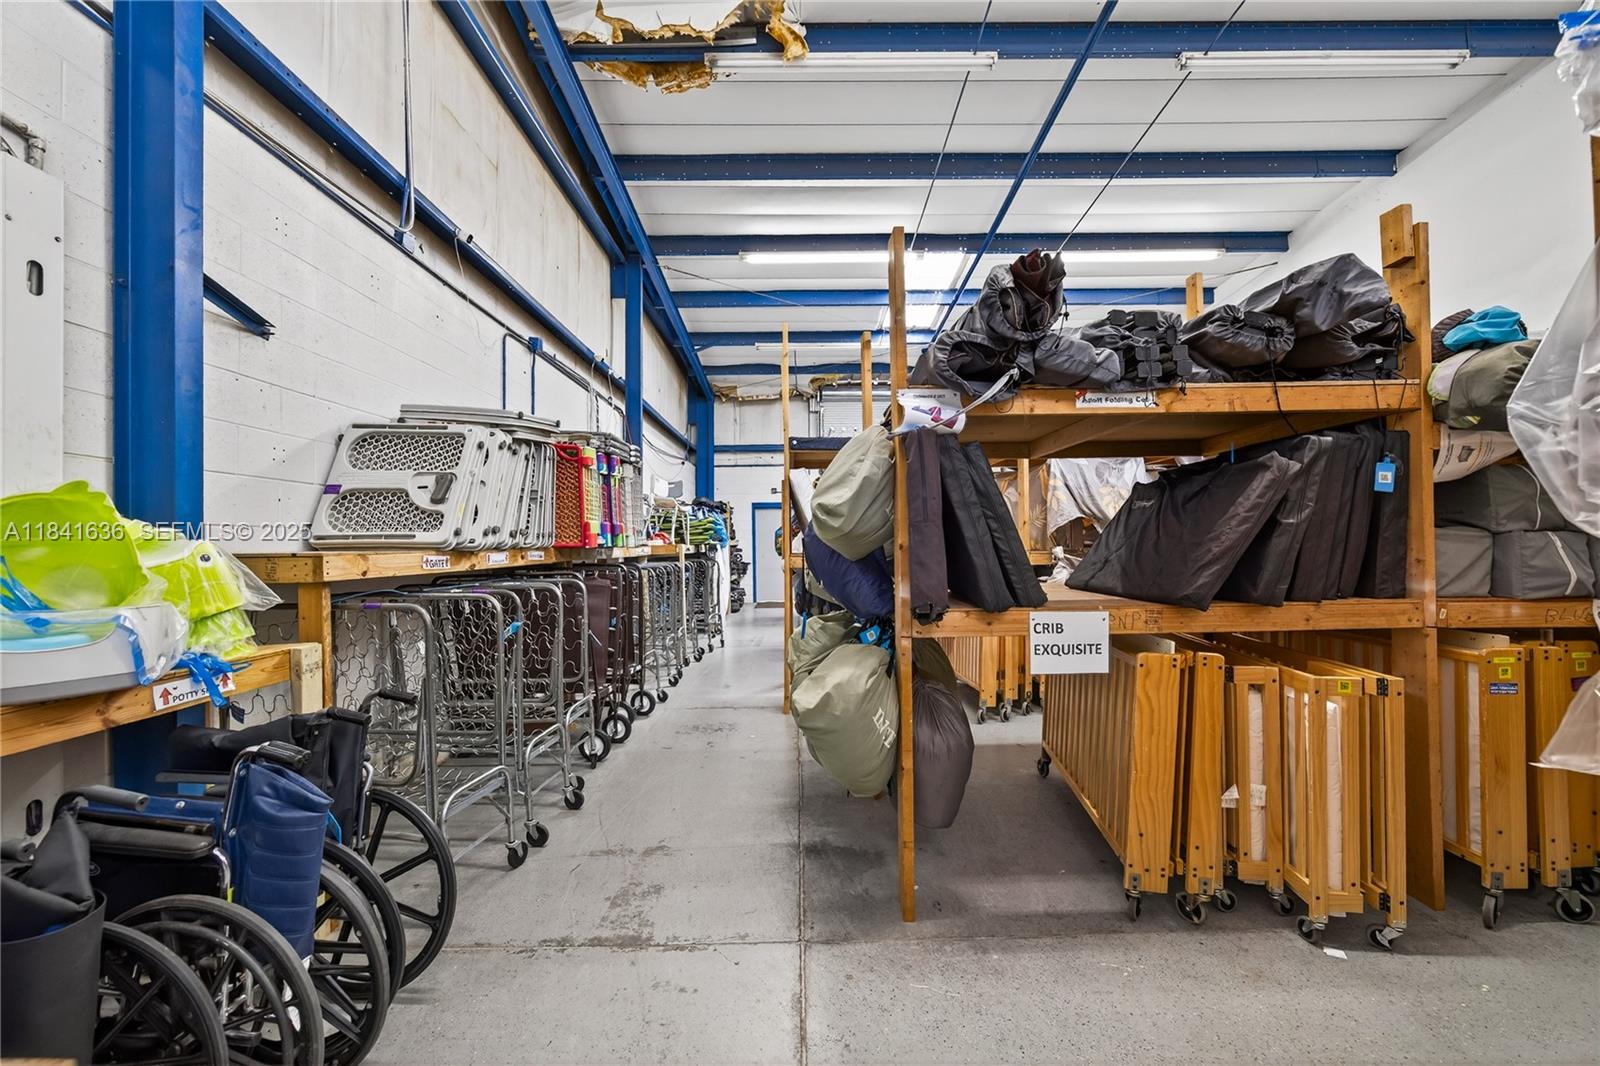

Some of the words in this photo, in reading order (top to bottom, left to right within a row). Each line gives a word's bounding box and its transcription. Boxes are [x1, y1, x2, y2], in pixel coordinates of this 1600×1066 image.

[1033, 622, 1064, 634] CRIB
[1034, 643, 1103, 657] EXQUISITE
[172, 688, 200, 704] POTTY
